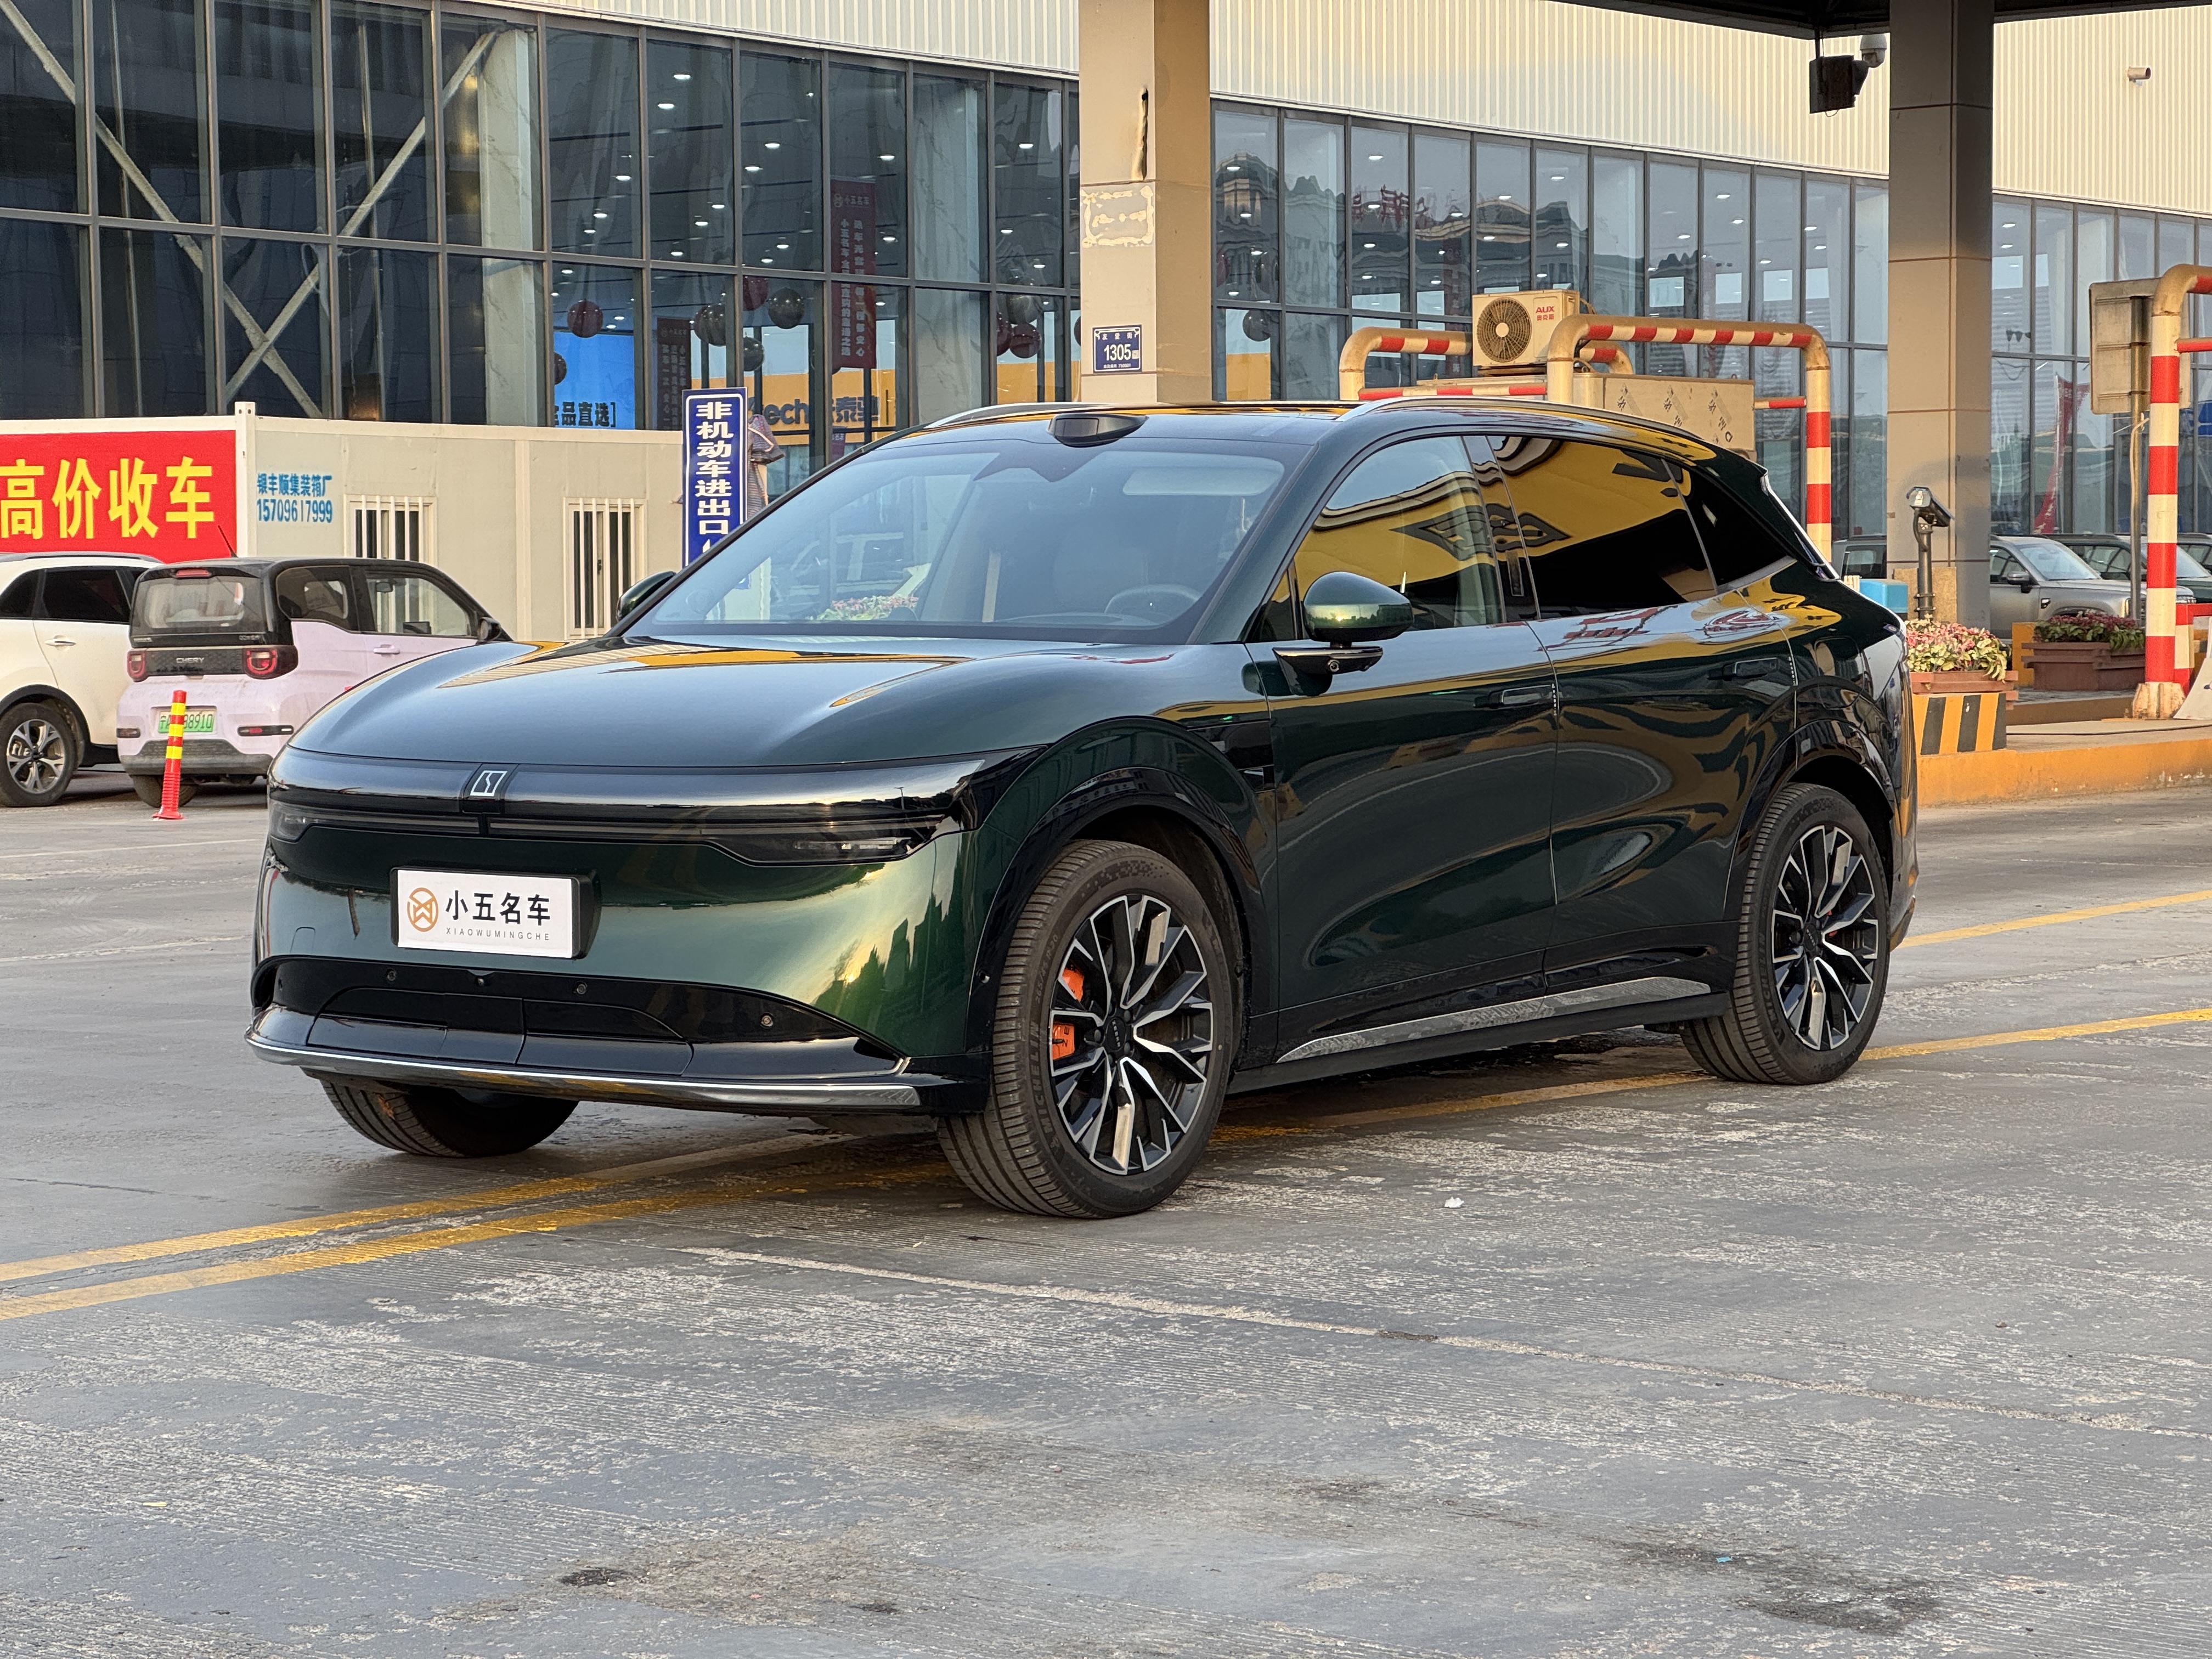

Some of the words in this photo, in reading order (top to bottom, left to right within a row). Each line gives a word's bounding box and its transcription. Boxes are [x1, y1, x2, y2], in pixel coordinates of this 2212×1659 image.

[1104, 343, 1131, 361] 1305
[695, 401, 734, 535] 非机动车进出口
[0, 456, 214, 539] 高价收车
[257, 498, 332, 523] 15709617999
[445, 890, 551, 926] 小五名车
[446, 927, 550, 941] XIAOWUMINGCHE
[1030, 1020, 1054, 1135] MICHELIN
